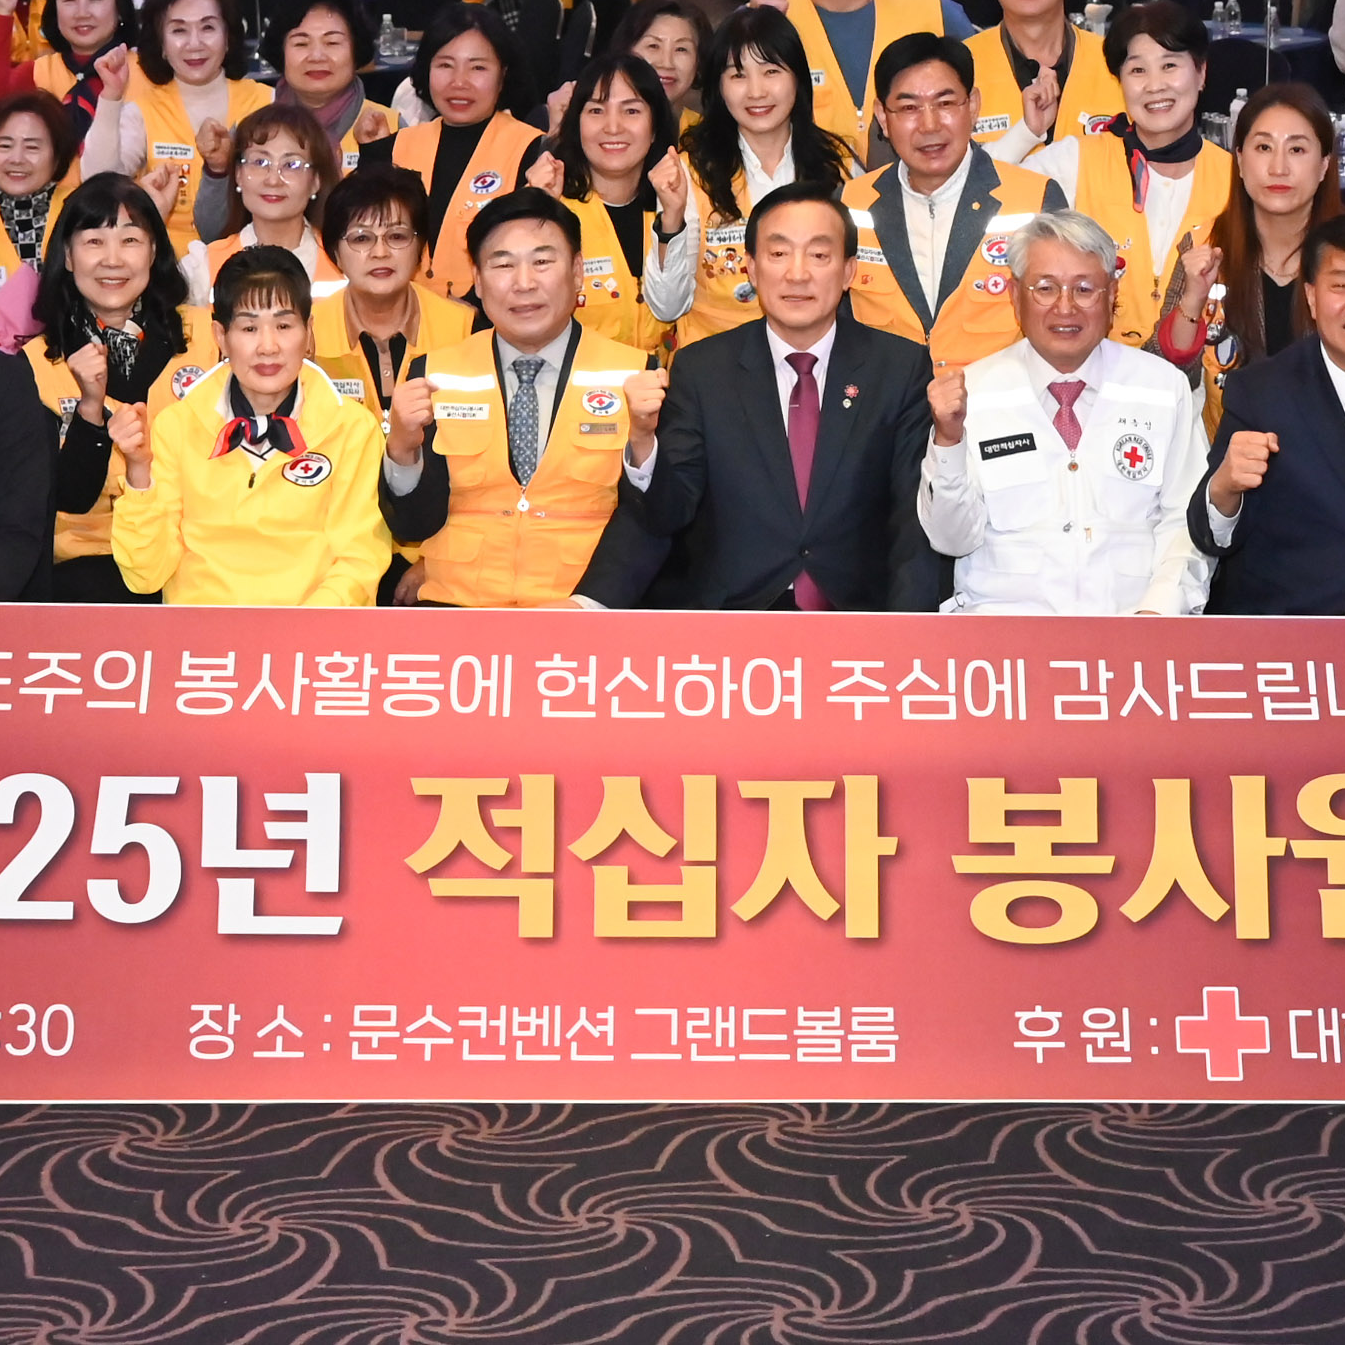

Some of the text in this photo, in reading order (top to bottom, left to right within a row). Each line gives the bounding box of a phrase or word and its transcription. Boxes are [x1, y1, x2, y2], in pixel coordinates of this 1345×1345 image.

[984, 438, 1031, 454] 대한적십자사
[174, 650, 513, 718] 봉사활동에
[534, 653, 803, 720] 헌신하여
[826, 658, 1027, 721] 주심에
[403, 773, 899, 939] 적십자
[348, 1004, 615, 1062] 문수컨벤션
[630, 1005, 900, 1063] 그랜드볼룸
